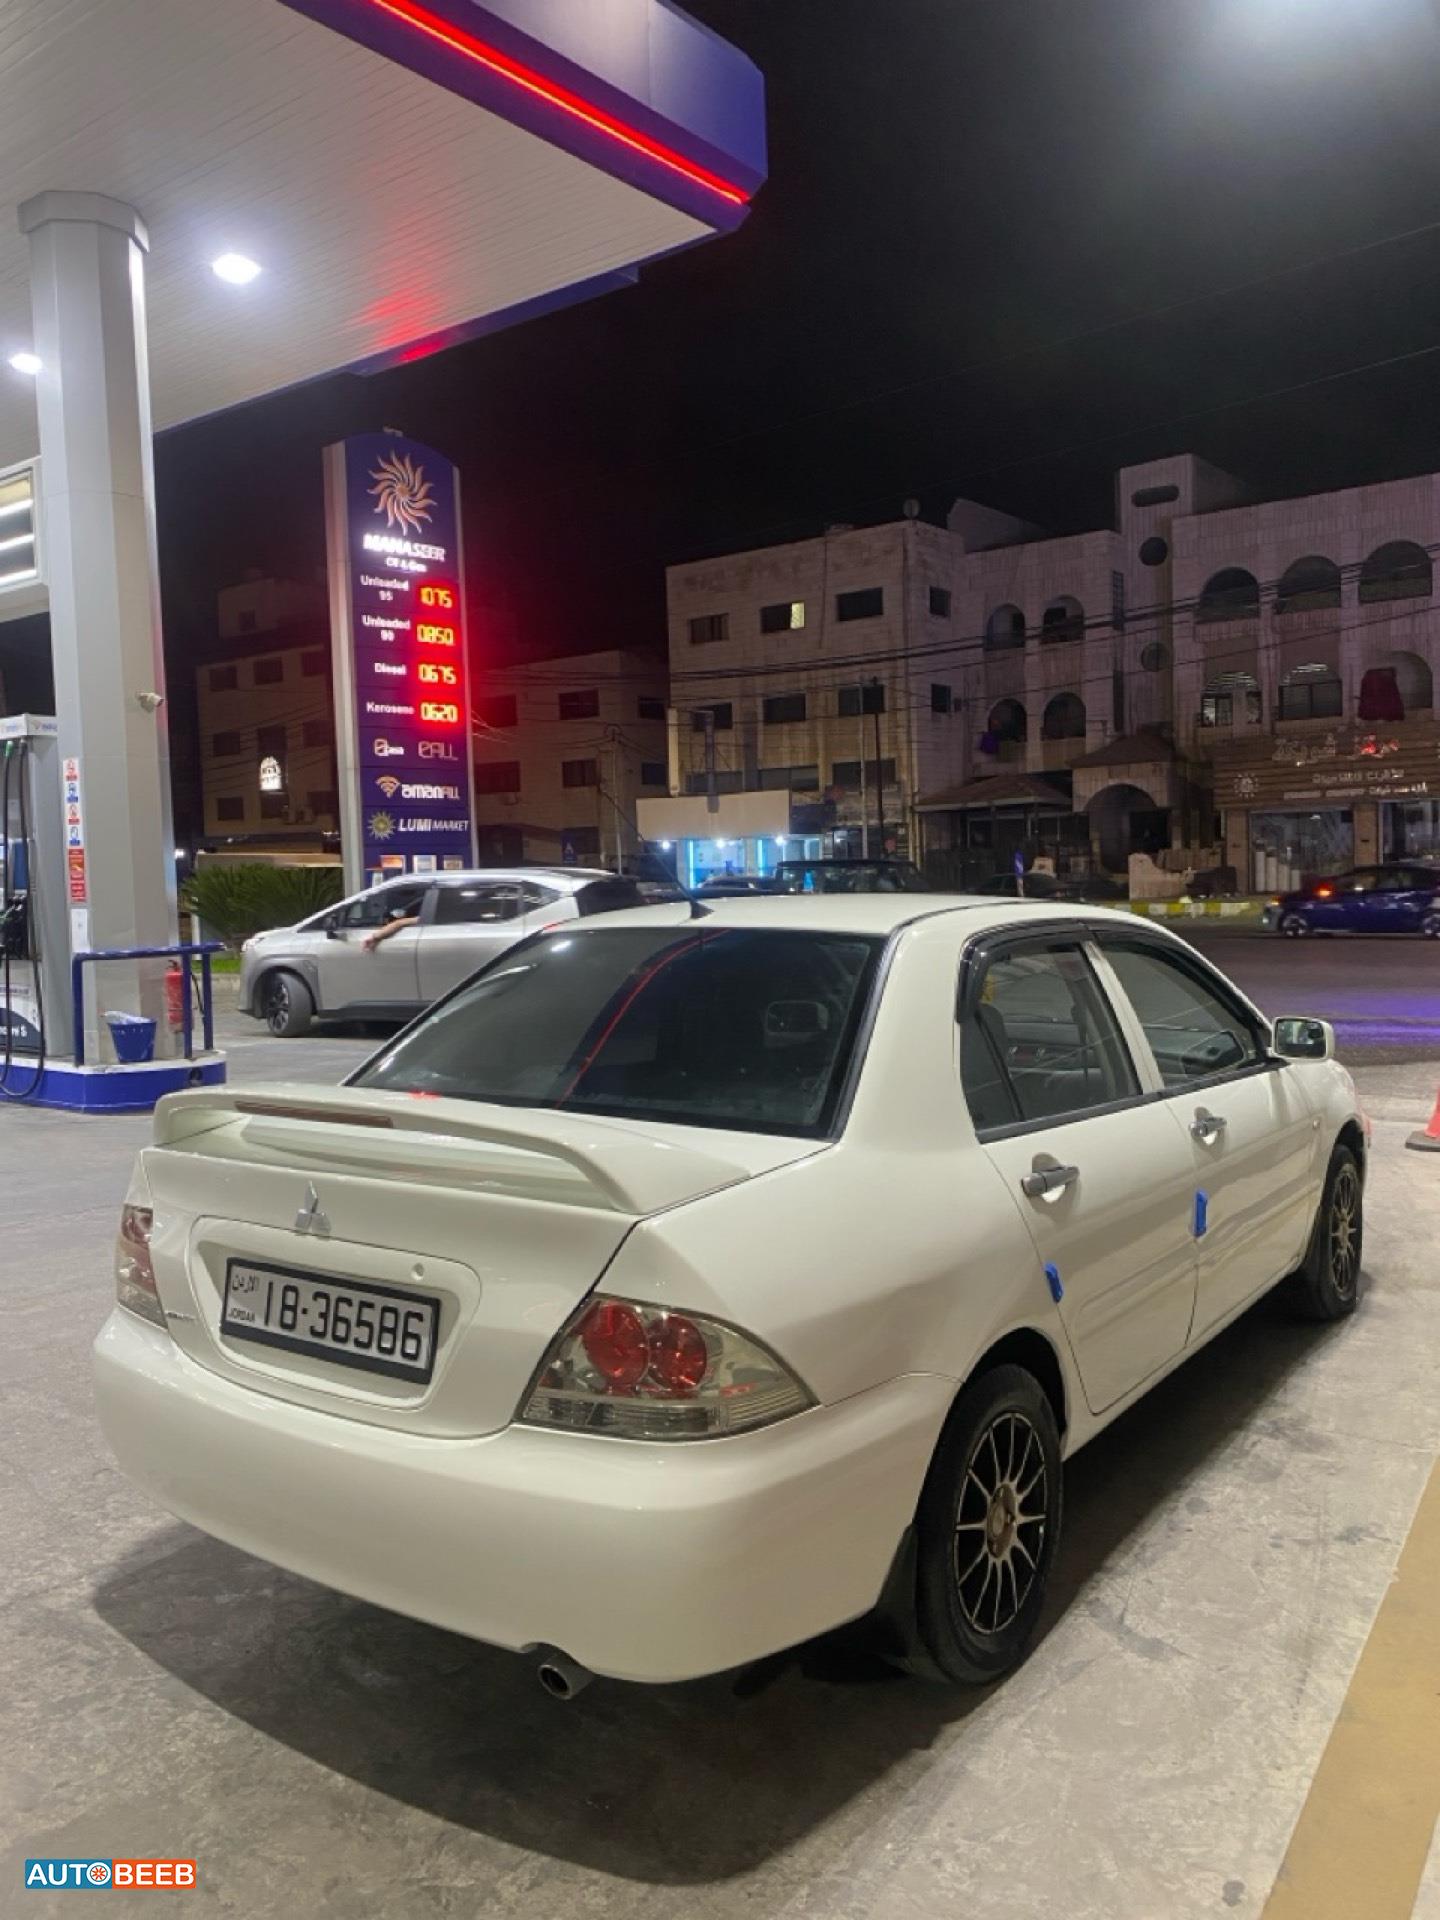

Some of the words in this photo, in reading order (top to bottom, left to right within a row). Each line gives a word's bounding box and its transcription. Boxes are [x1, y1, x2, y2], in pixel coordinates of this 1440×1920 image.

[363, 533, 445, 561] MANASEER
[361, 575, 409, 591] Unleaded
[362, 615, 411, 630] Unleaded
[374, 662, 407, 675] Diesel
[366, 702, 414, 714] Kerosene
[398, 819, 432, 832] LUMI
[432, 820, 468, 831] MARKET
[228, 1307, 255, 1322] JORDAN
